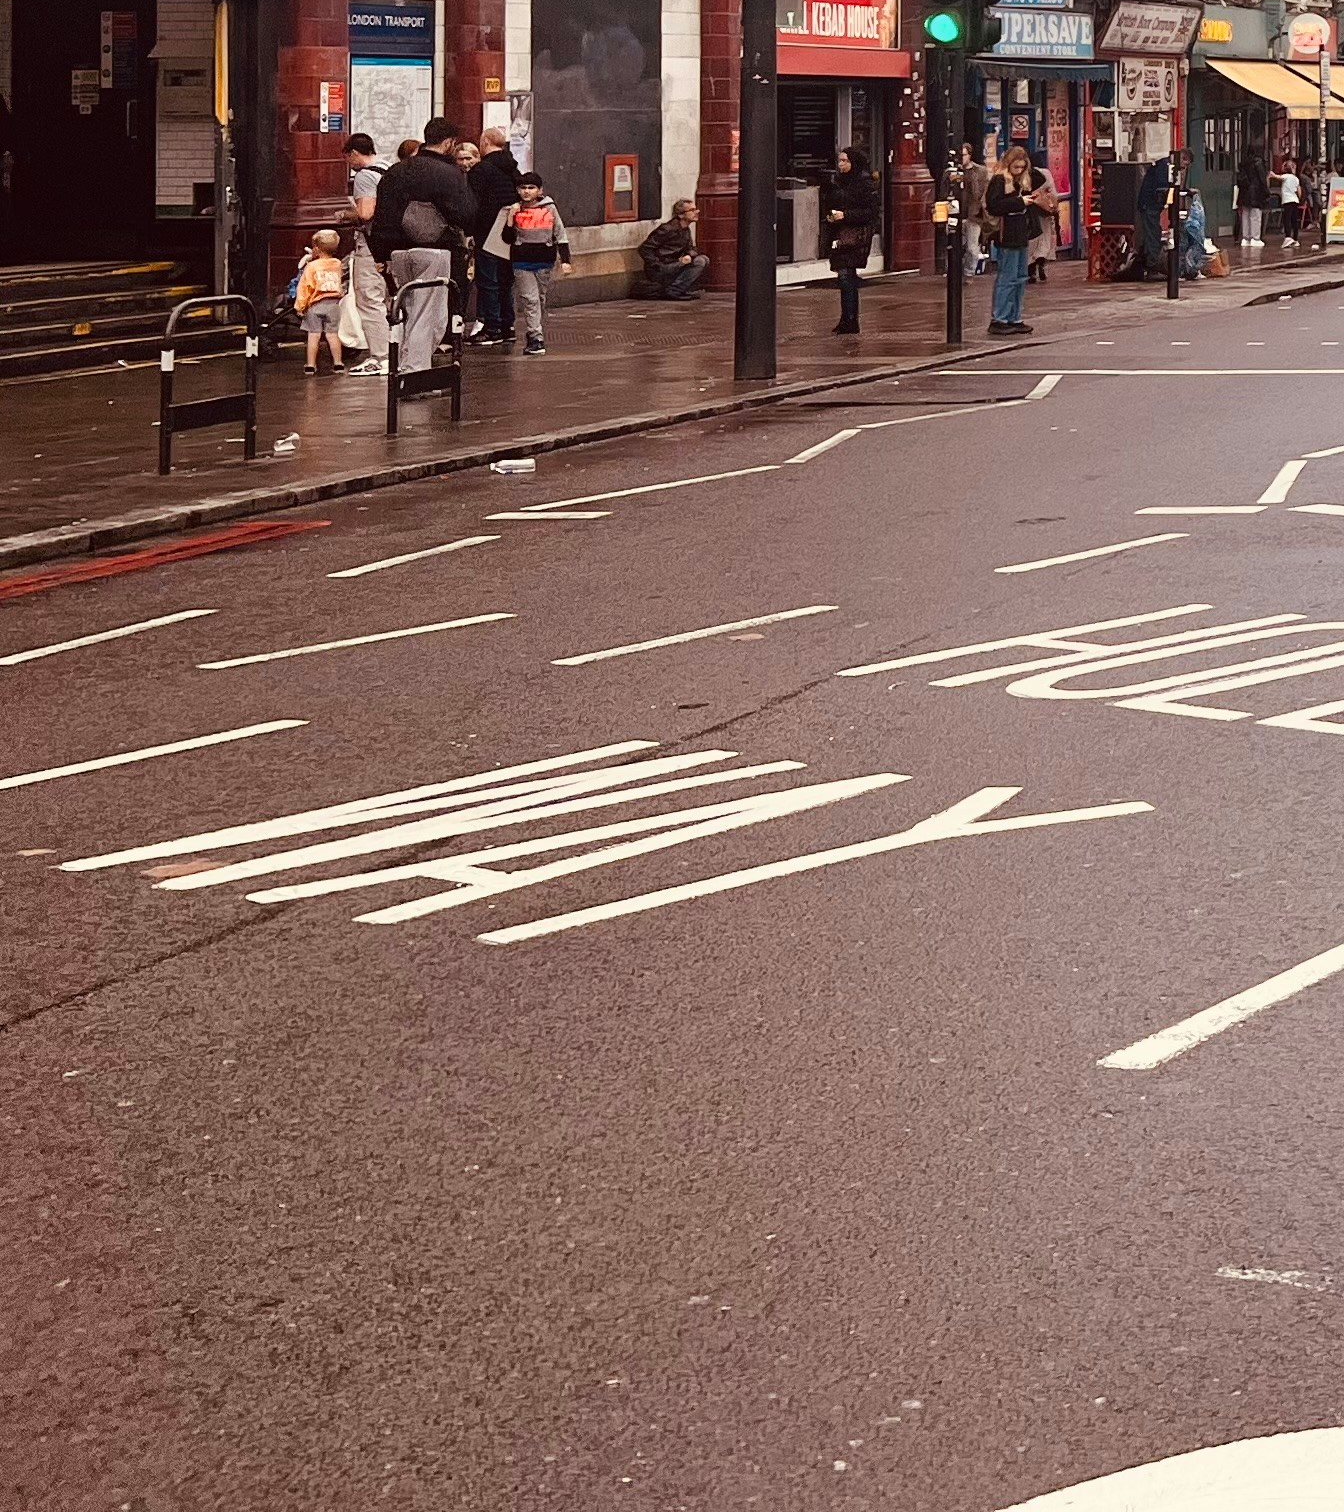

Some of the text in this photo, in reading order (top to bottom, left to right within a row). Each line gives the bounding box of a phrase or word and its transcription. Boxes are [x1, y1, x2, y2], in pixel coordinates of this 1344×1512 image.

[348, 14, 425, 28] LONDON TRANSPORT
[811, 1, 846, 37] KEBAB
[847, 5, 880, 39] HOUSE
[56, 739, 1155, 945] WAY
